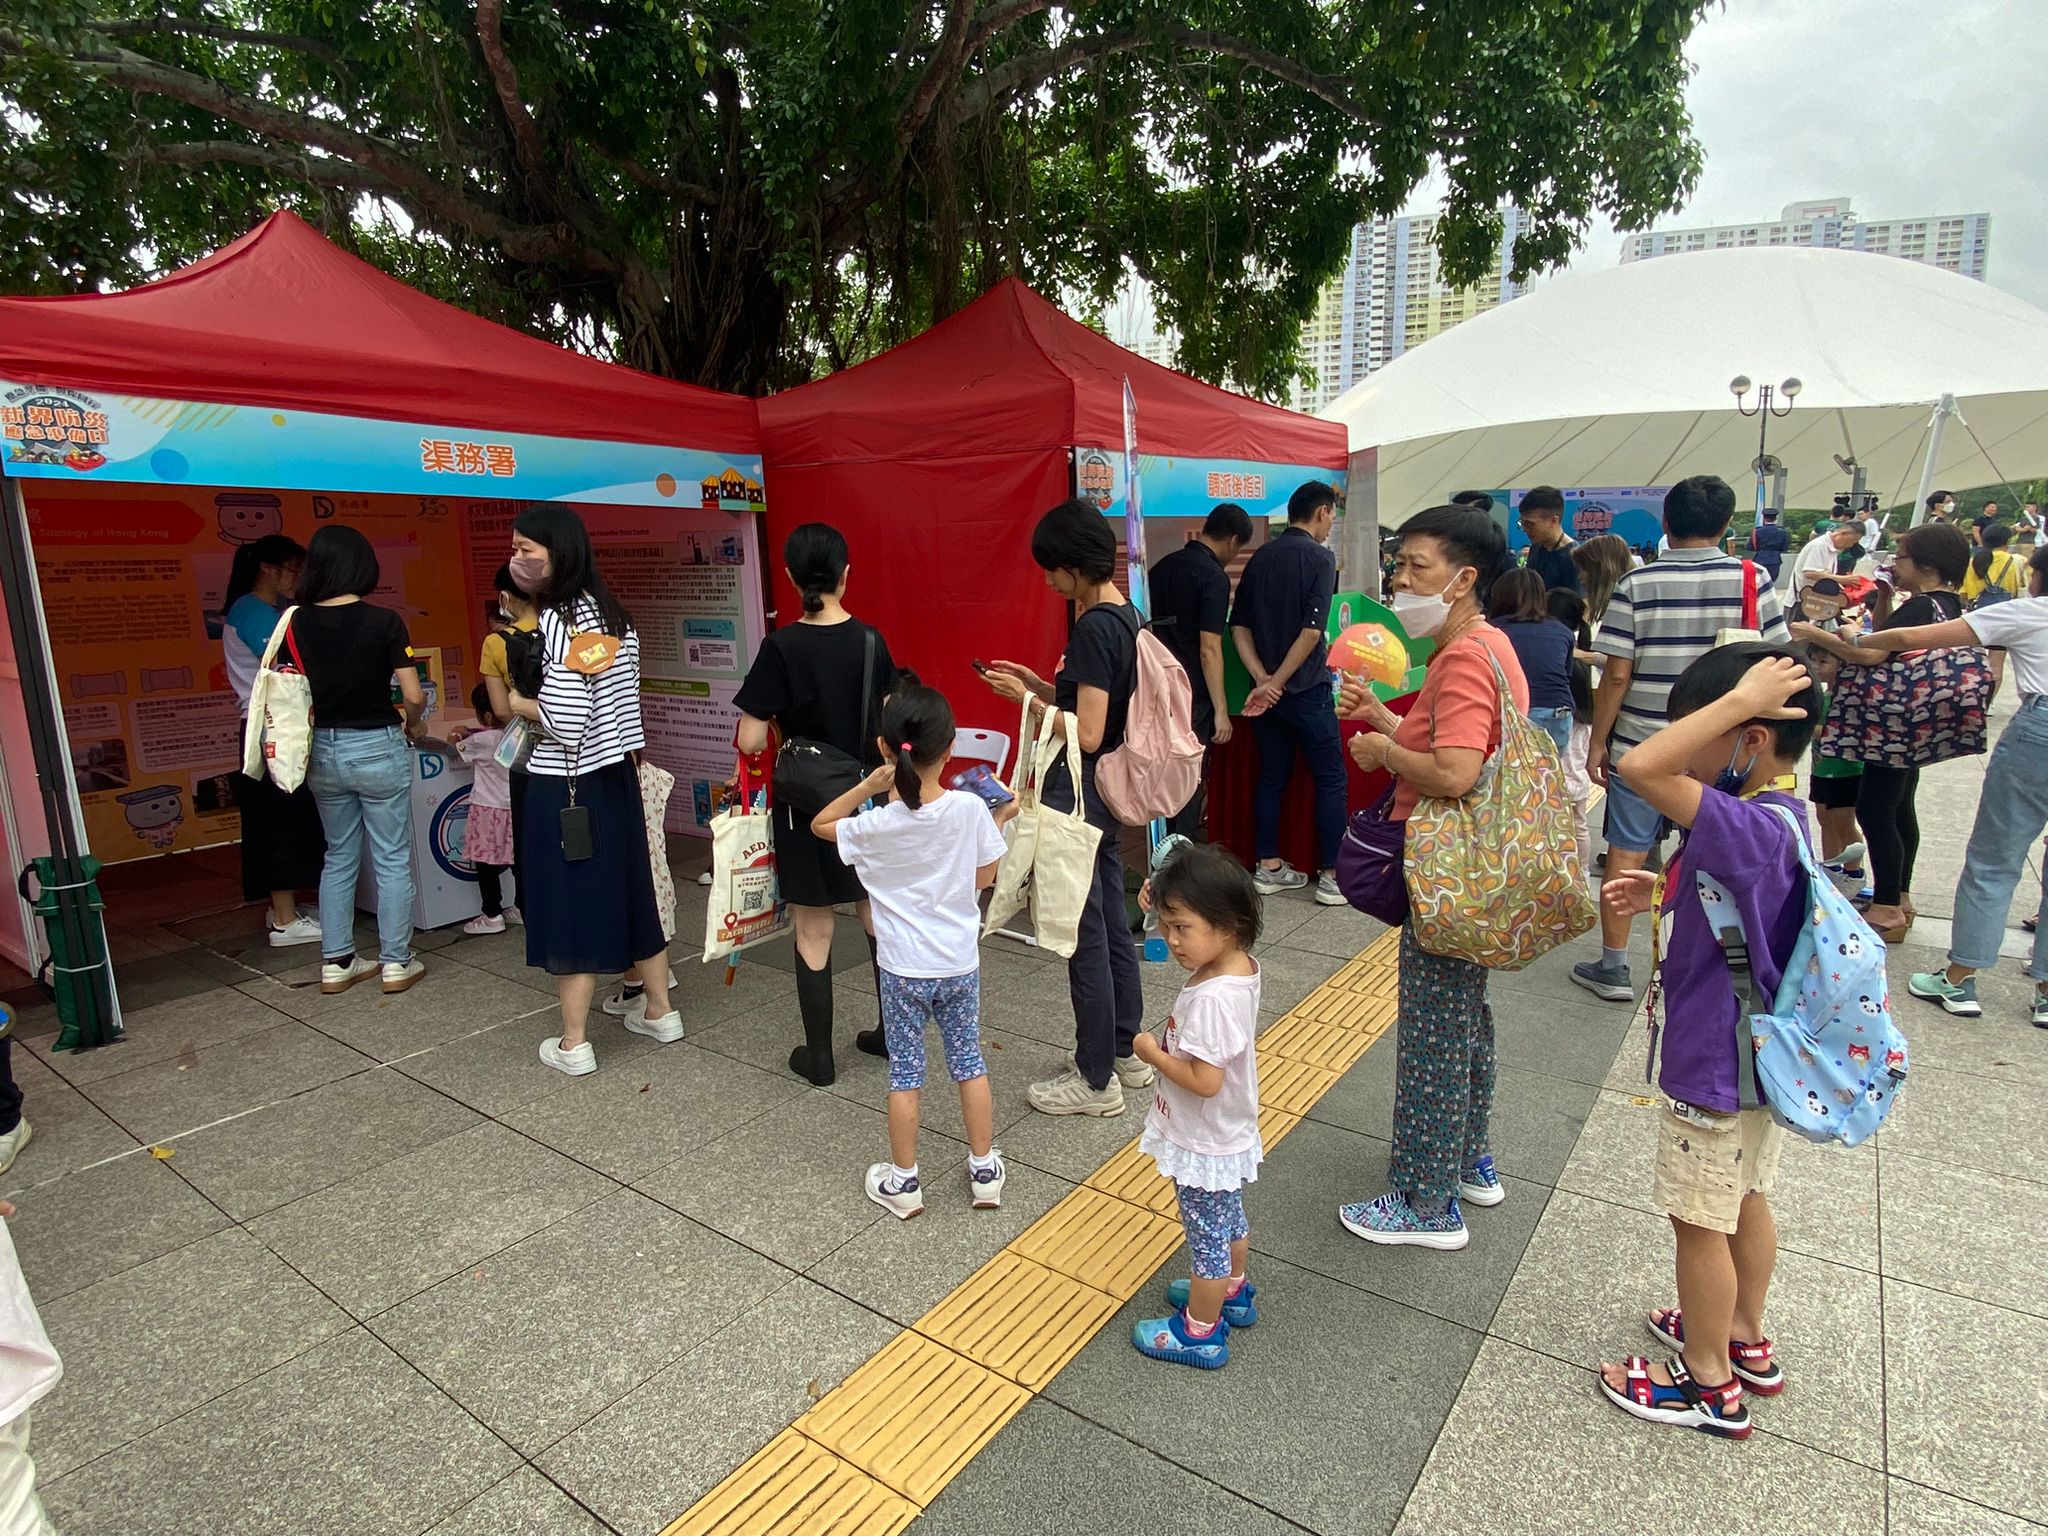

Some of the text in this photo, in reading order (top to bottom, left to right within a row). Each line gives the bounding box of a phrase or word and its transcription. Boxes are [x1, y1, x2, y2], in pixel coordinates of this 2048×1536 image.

[35, 397, 69, 407] 2024
[0, 406, 107, 429] 新界防災
[420, 438, 517, 477] 渠務署
[1207, 472, 1265, 499] 調派後指引
[106, 528, 137, 538] Hong
[140, 528, 169, 539] Kong
